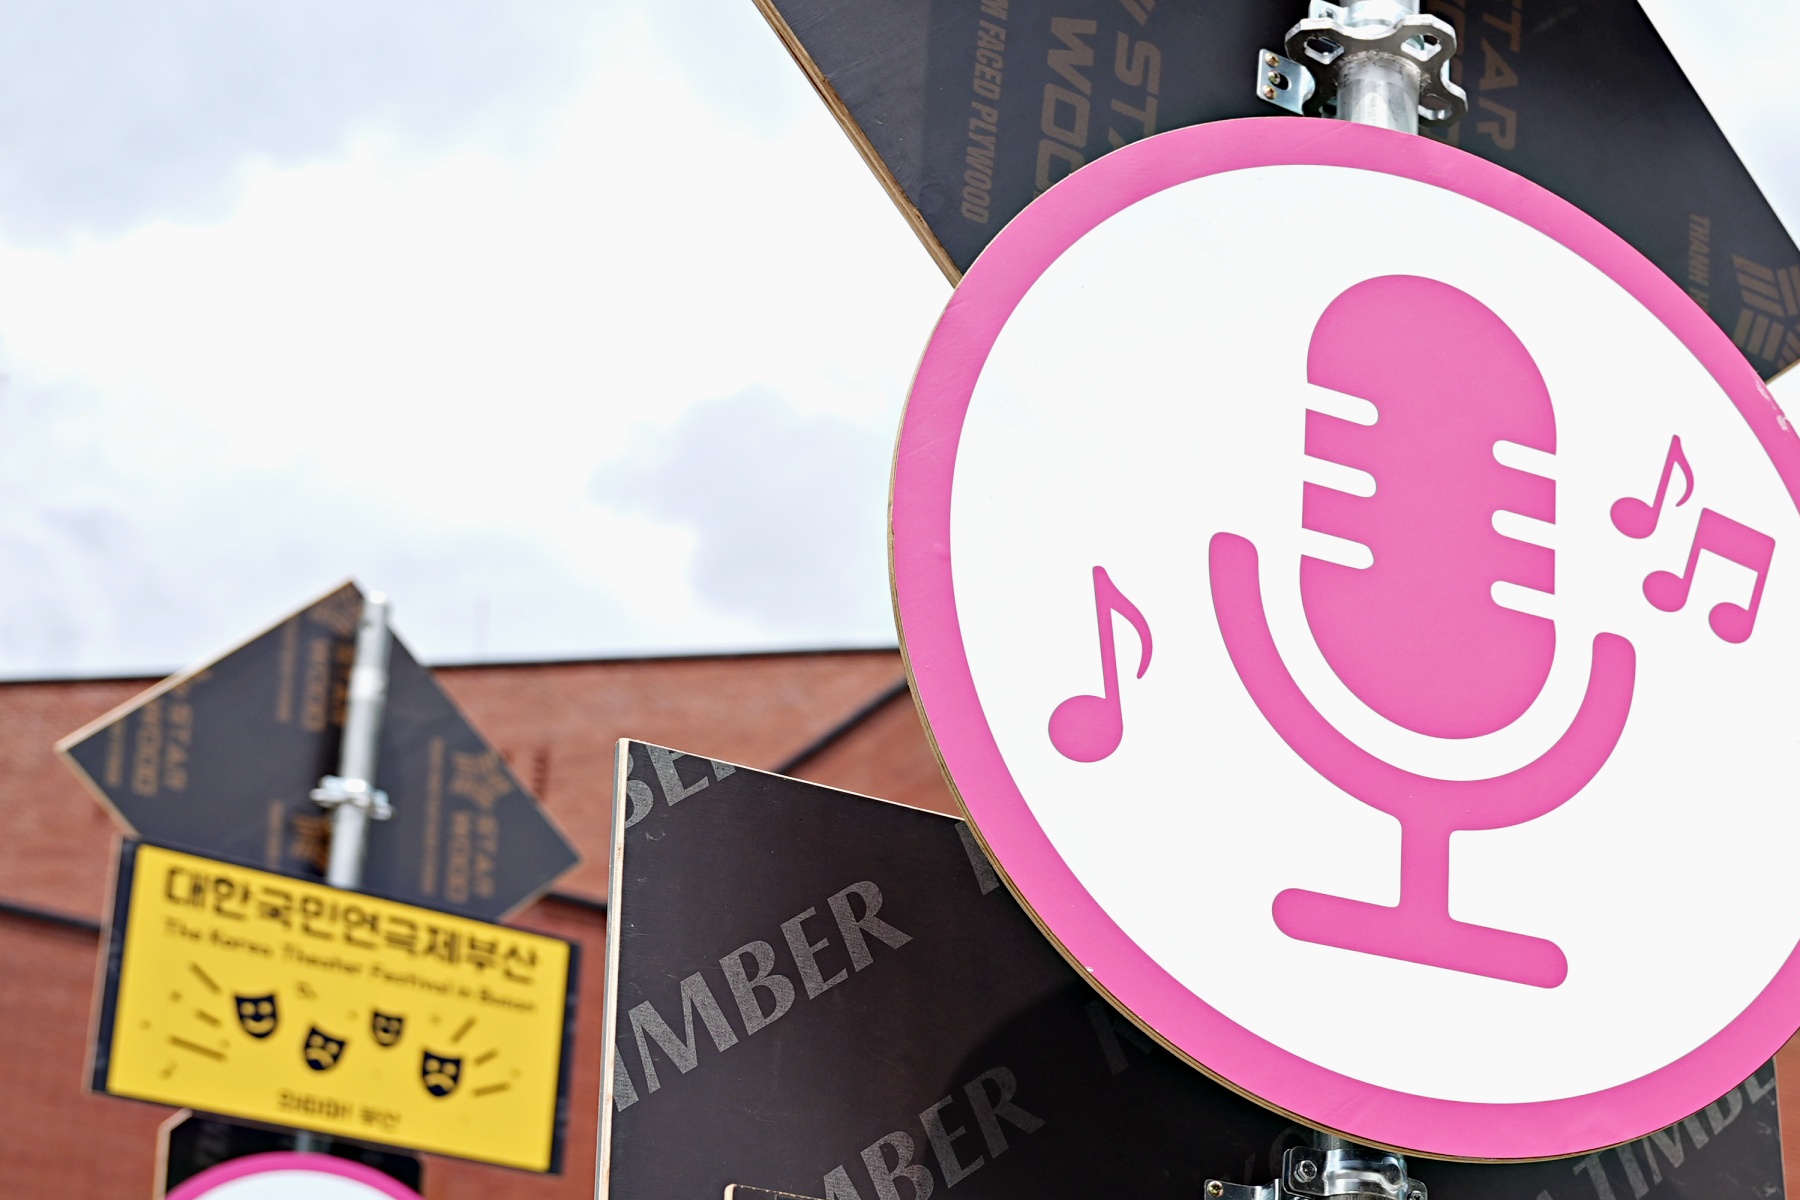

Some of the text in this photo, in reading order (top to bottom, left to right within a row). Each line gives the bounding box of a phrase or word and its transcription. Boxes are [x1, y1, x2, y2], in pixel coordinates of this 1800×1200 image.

[973, 19, 1007, 100] FACED
[1034, 16, 1099, 200] WOO
[1476, 0, 1523, 151] TAR
[961, 101, 1000, 224] PLYWOOD
[1687, 213, 1712, 288] THANH
[613, 879, 913, 1112] IMBER
